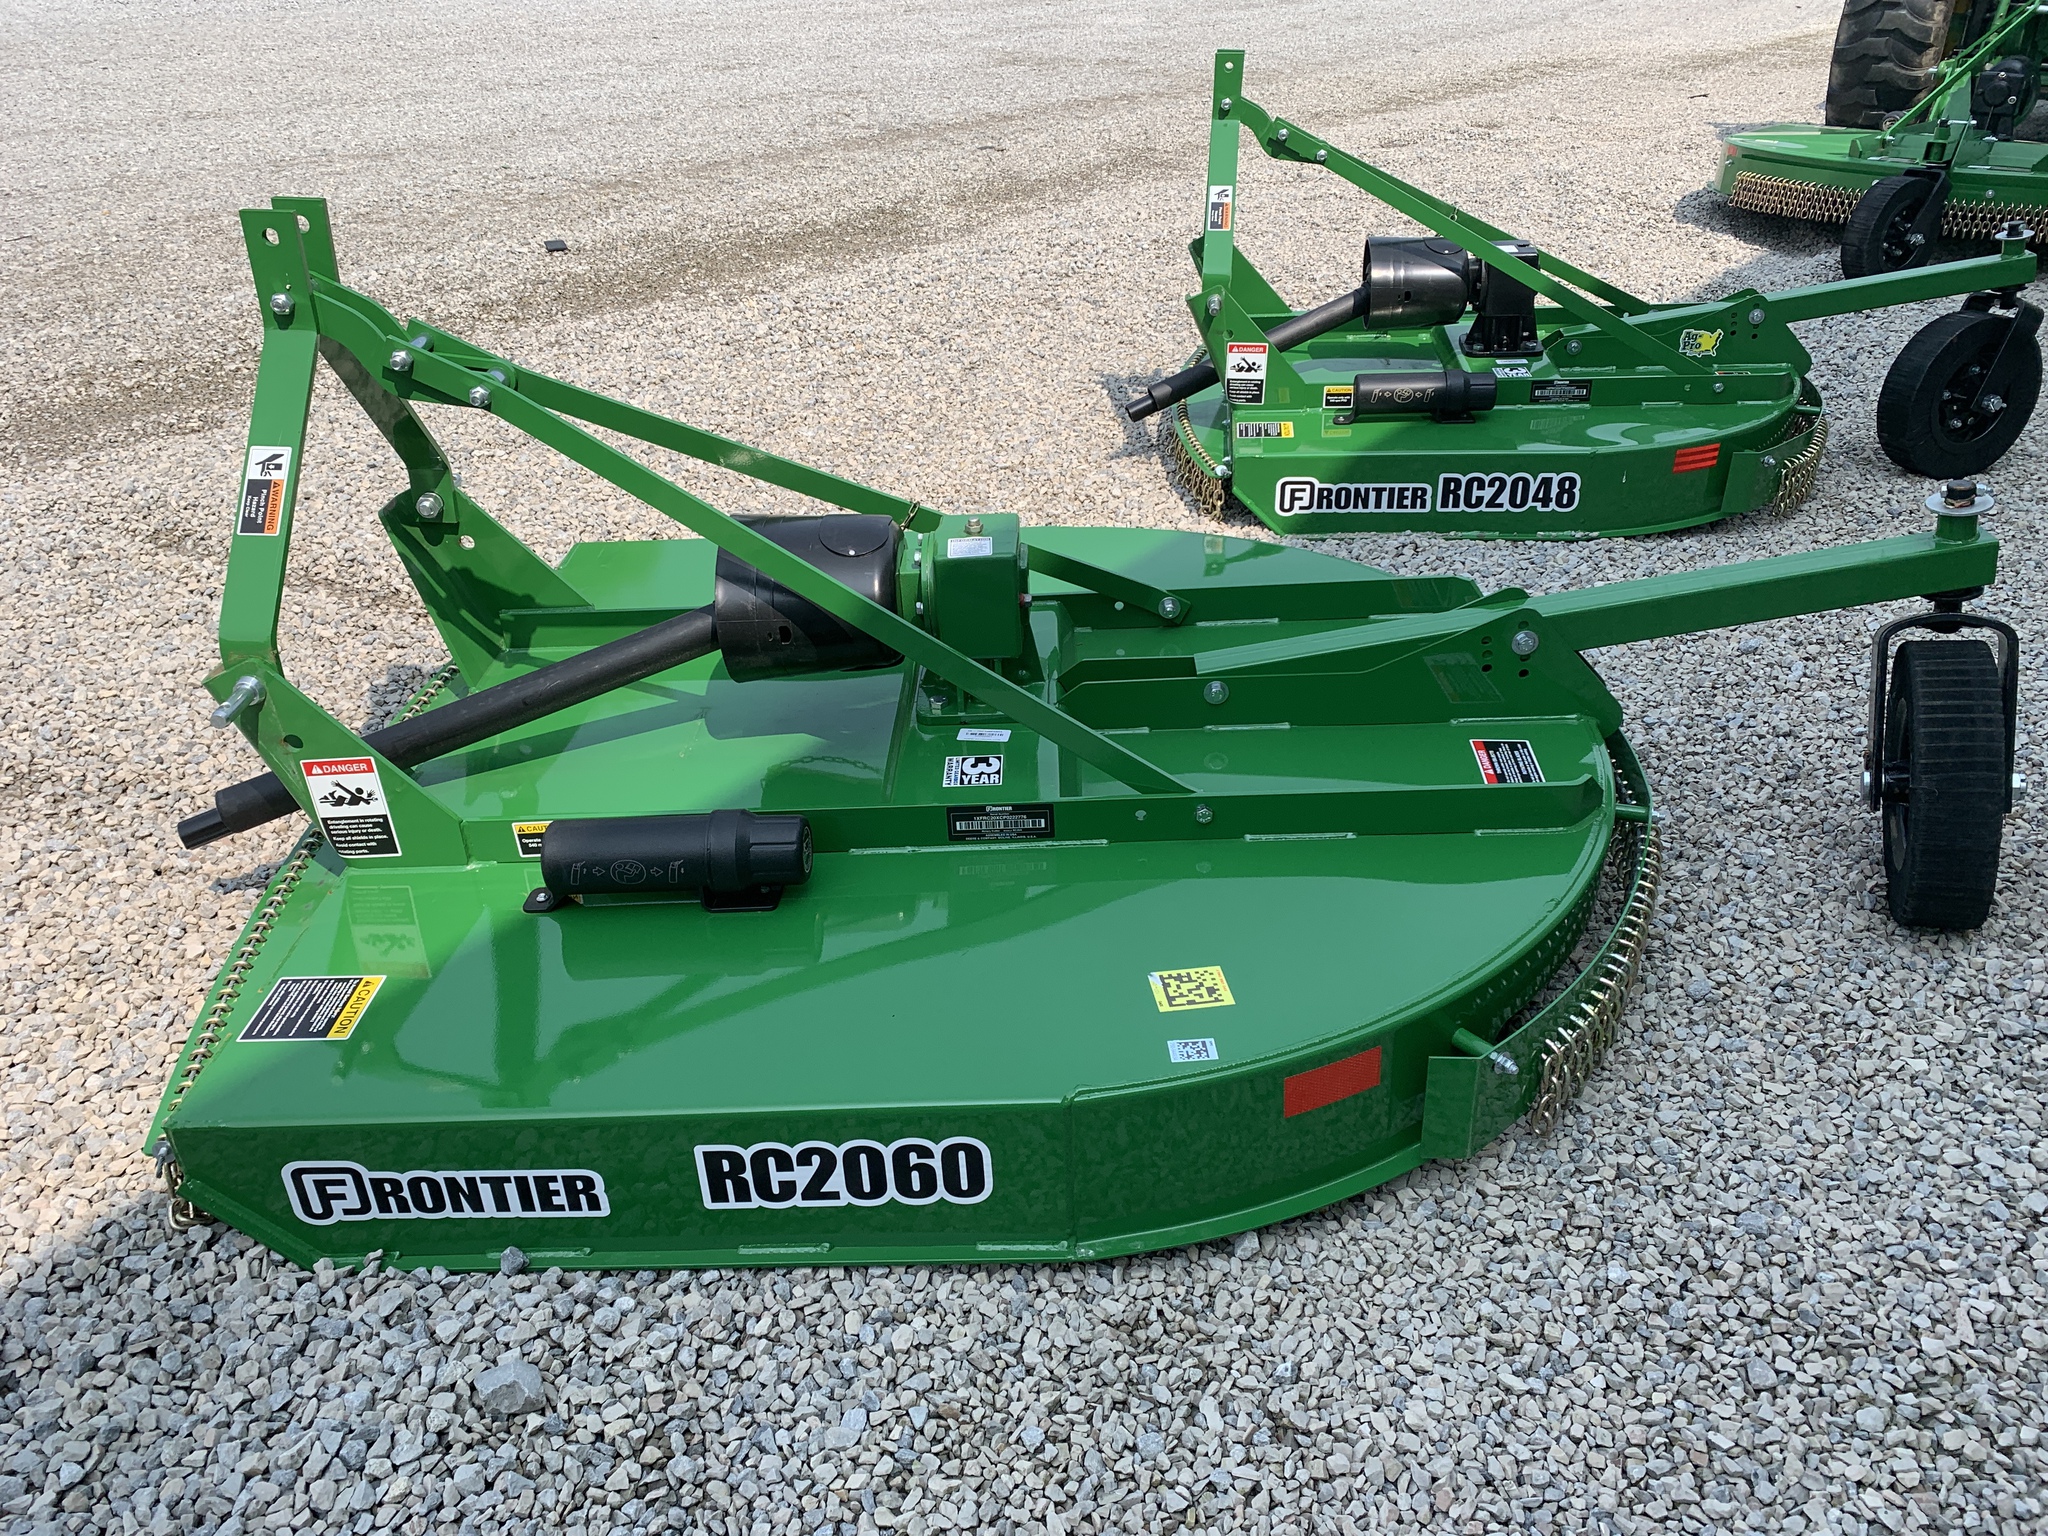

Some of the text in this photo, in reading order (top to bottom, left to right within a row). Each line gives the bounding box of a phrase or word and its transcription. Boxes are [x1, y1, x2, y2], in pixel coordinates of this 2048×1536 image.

[1683, 341, 1701, 350] Pro
[1280, 476, 1578, 513] FRONTIER RC2048
[250, 497, 258, 517] Hazard
[267, 490, 280, 530] WARNING
[323, 763, 368, 773] DANGER
[962, 757, 1000, 775] 3
[1477, 750, 1492, 769] DANGER
[961, 774, 1000, 785] YEAR
[334, 989, 370, 1034] CAUTION
[290, 1143, 987, 1222] FRONTIER RC2060
